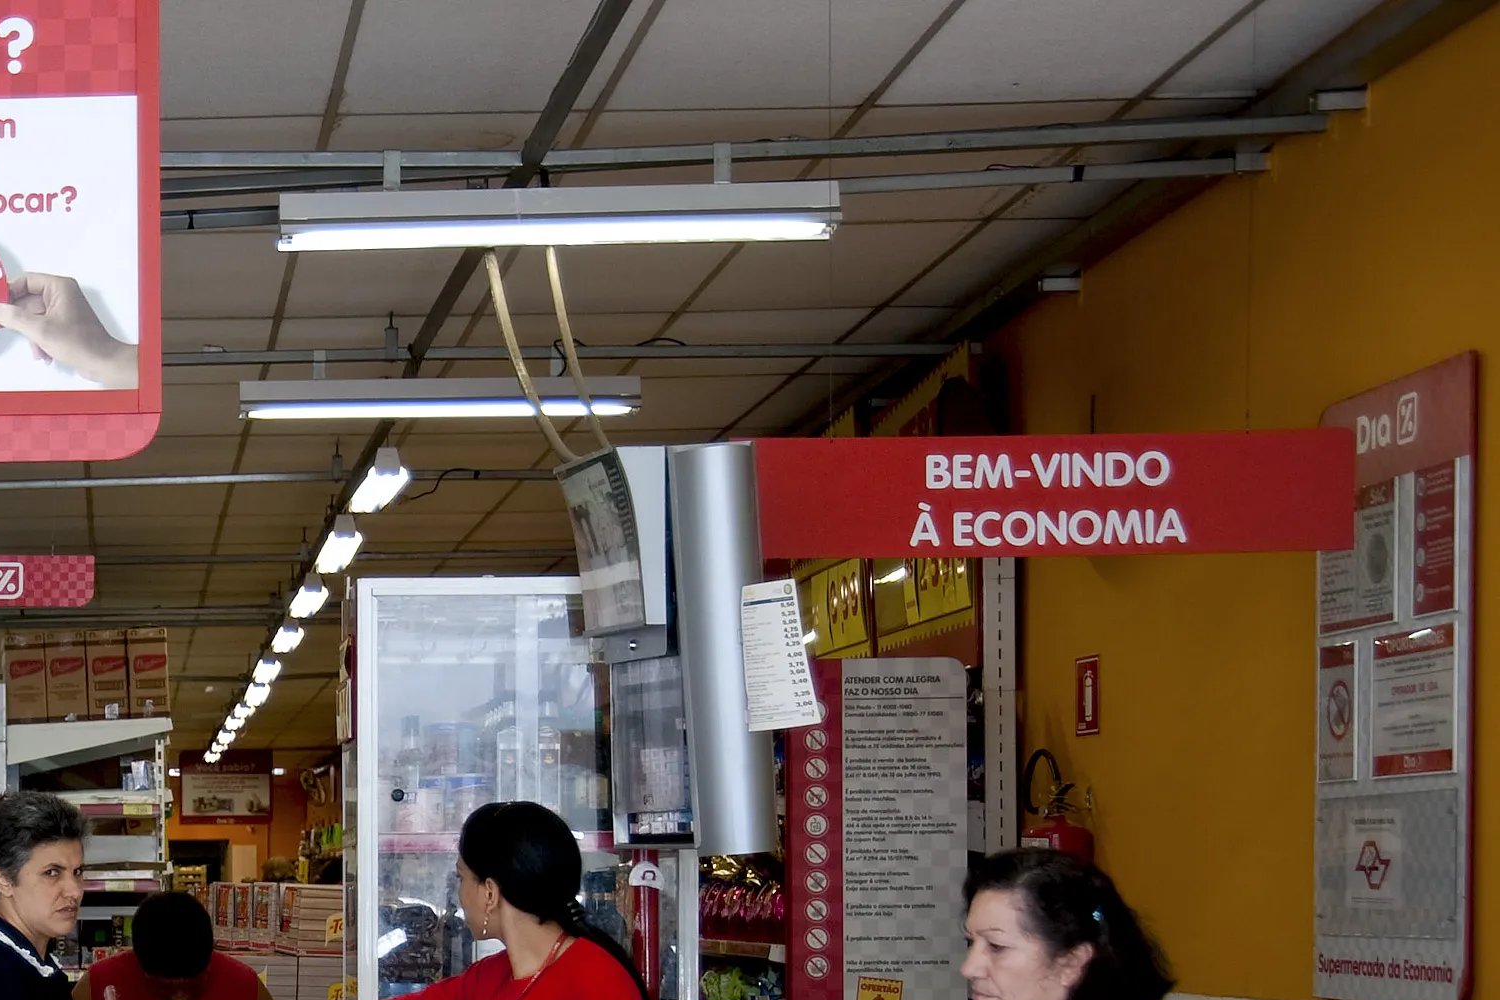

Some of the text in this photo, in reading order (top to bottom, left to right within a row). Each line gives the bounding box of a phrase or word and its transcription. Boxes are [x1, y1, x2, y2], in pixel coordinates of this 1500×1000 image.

[925, 451, 1171, 490] BEM-VINDO
[909, 502, 1187, 547] À ECONOMIA
[845, 676, 880, 684] ATENDER
[844, 688, 859, 696] FAZ
[1318, 953, 1453, 983] Supermercado da Economia
[860, 983, 899, 994] OFERTÃO
